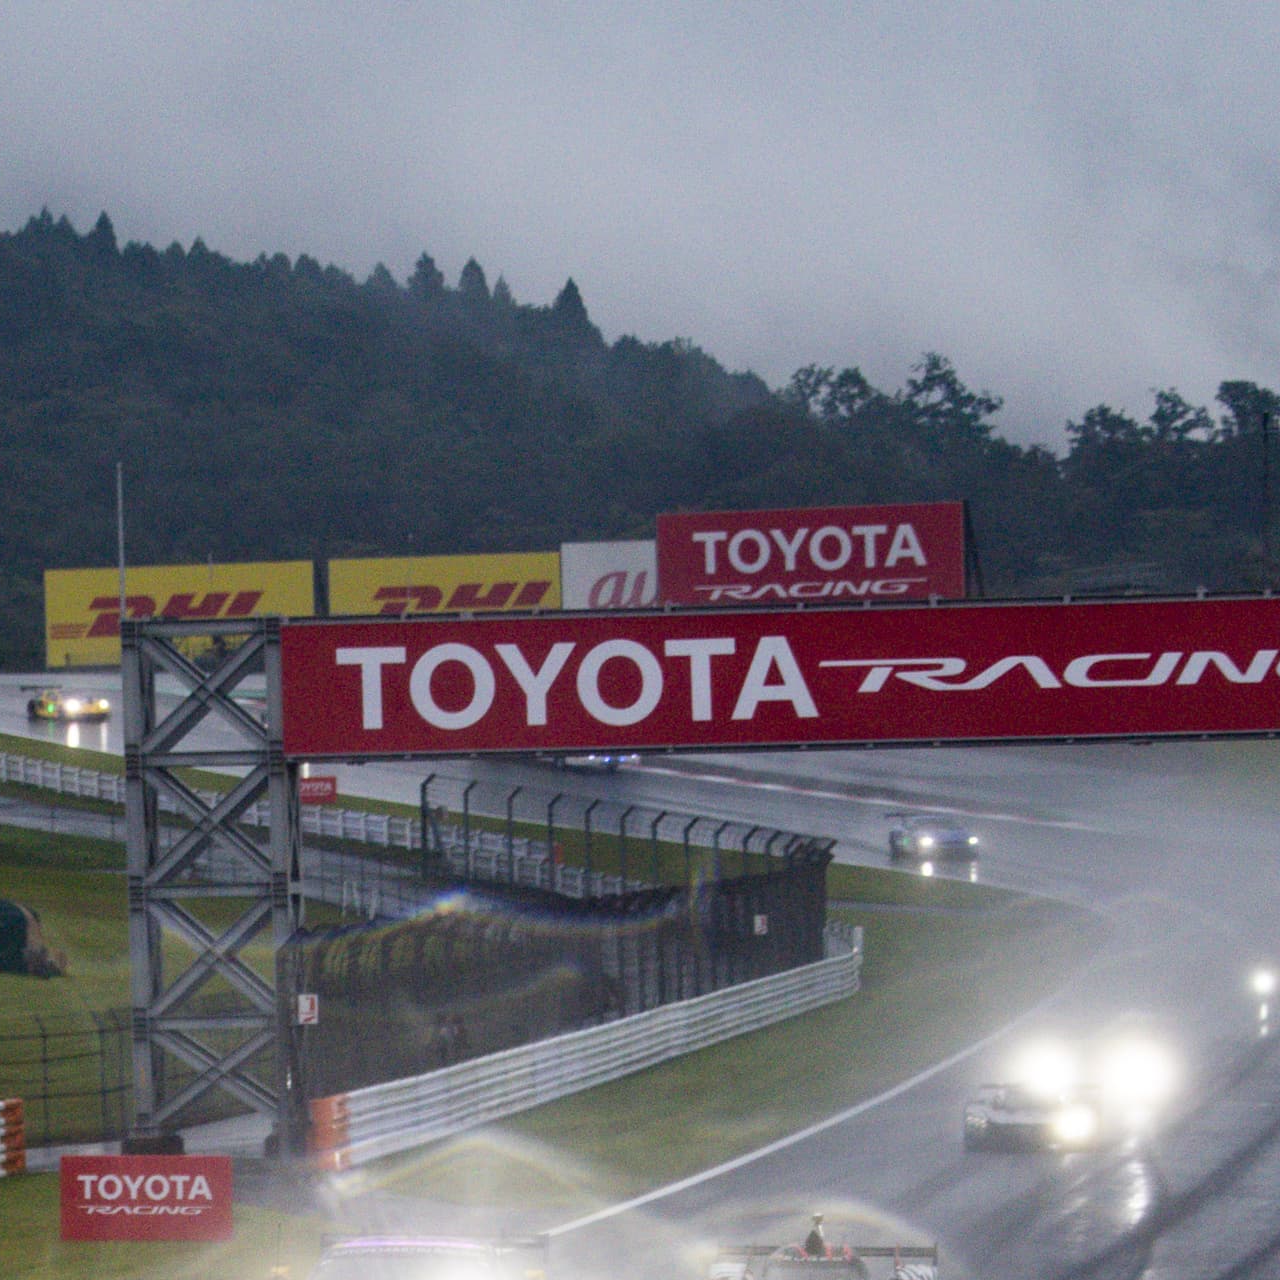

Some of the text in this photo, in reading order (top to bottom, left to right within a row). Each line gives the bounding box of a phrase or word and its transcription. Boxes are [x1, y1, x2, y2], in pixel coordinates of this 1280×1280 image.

[693, 523, 927, 575] TOYOTA
[694, 578, 927, 600] RACING
[335, 636, 820, 731] TOYOTA
[77, 1174, 213, 1200] TOYOTA
[78, 1205, 212, 1215] RACING
